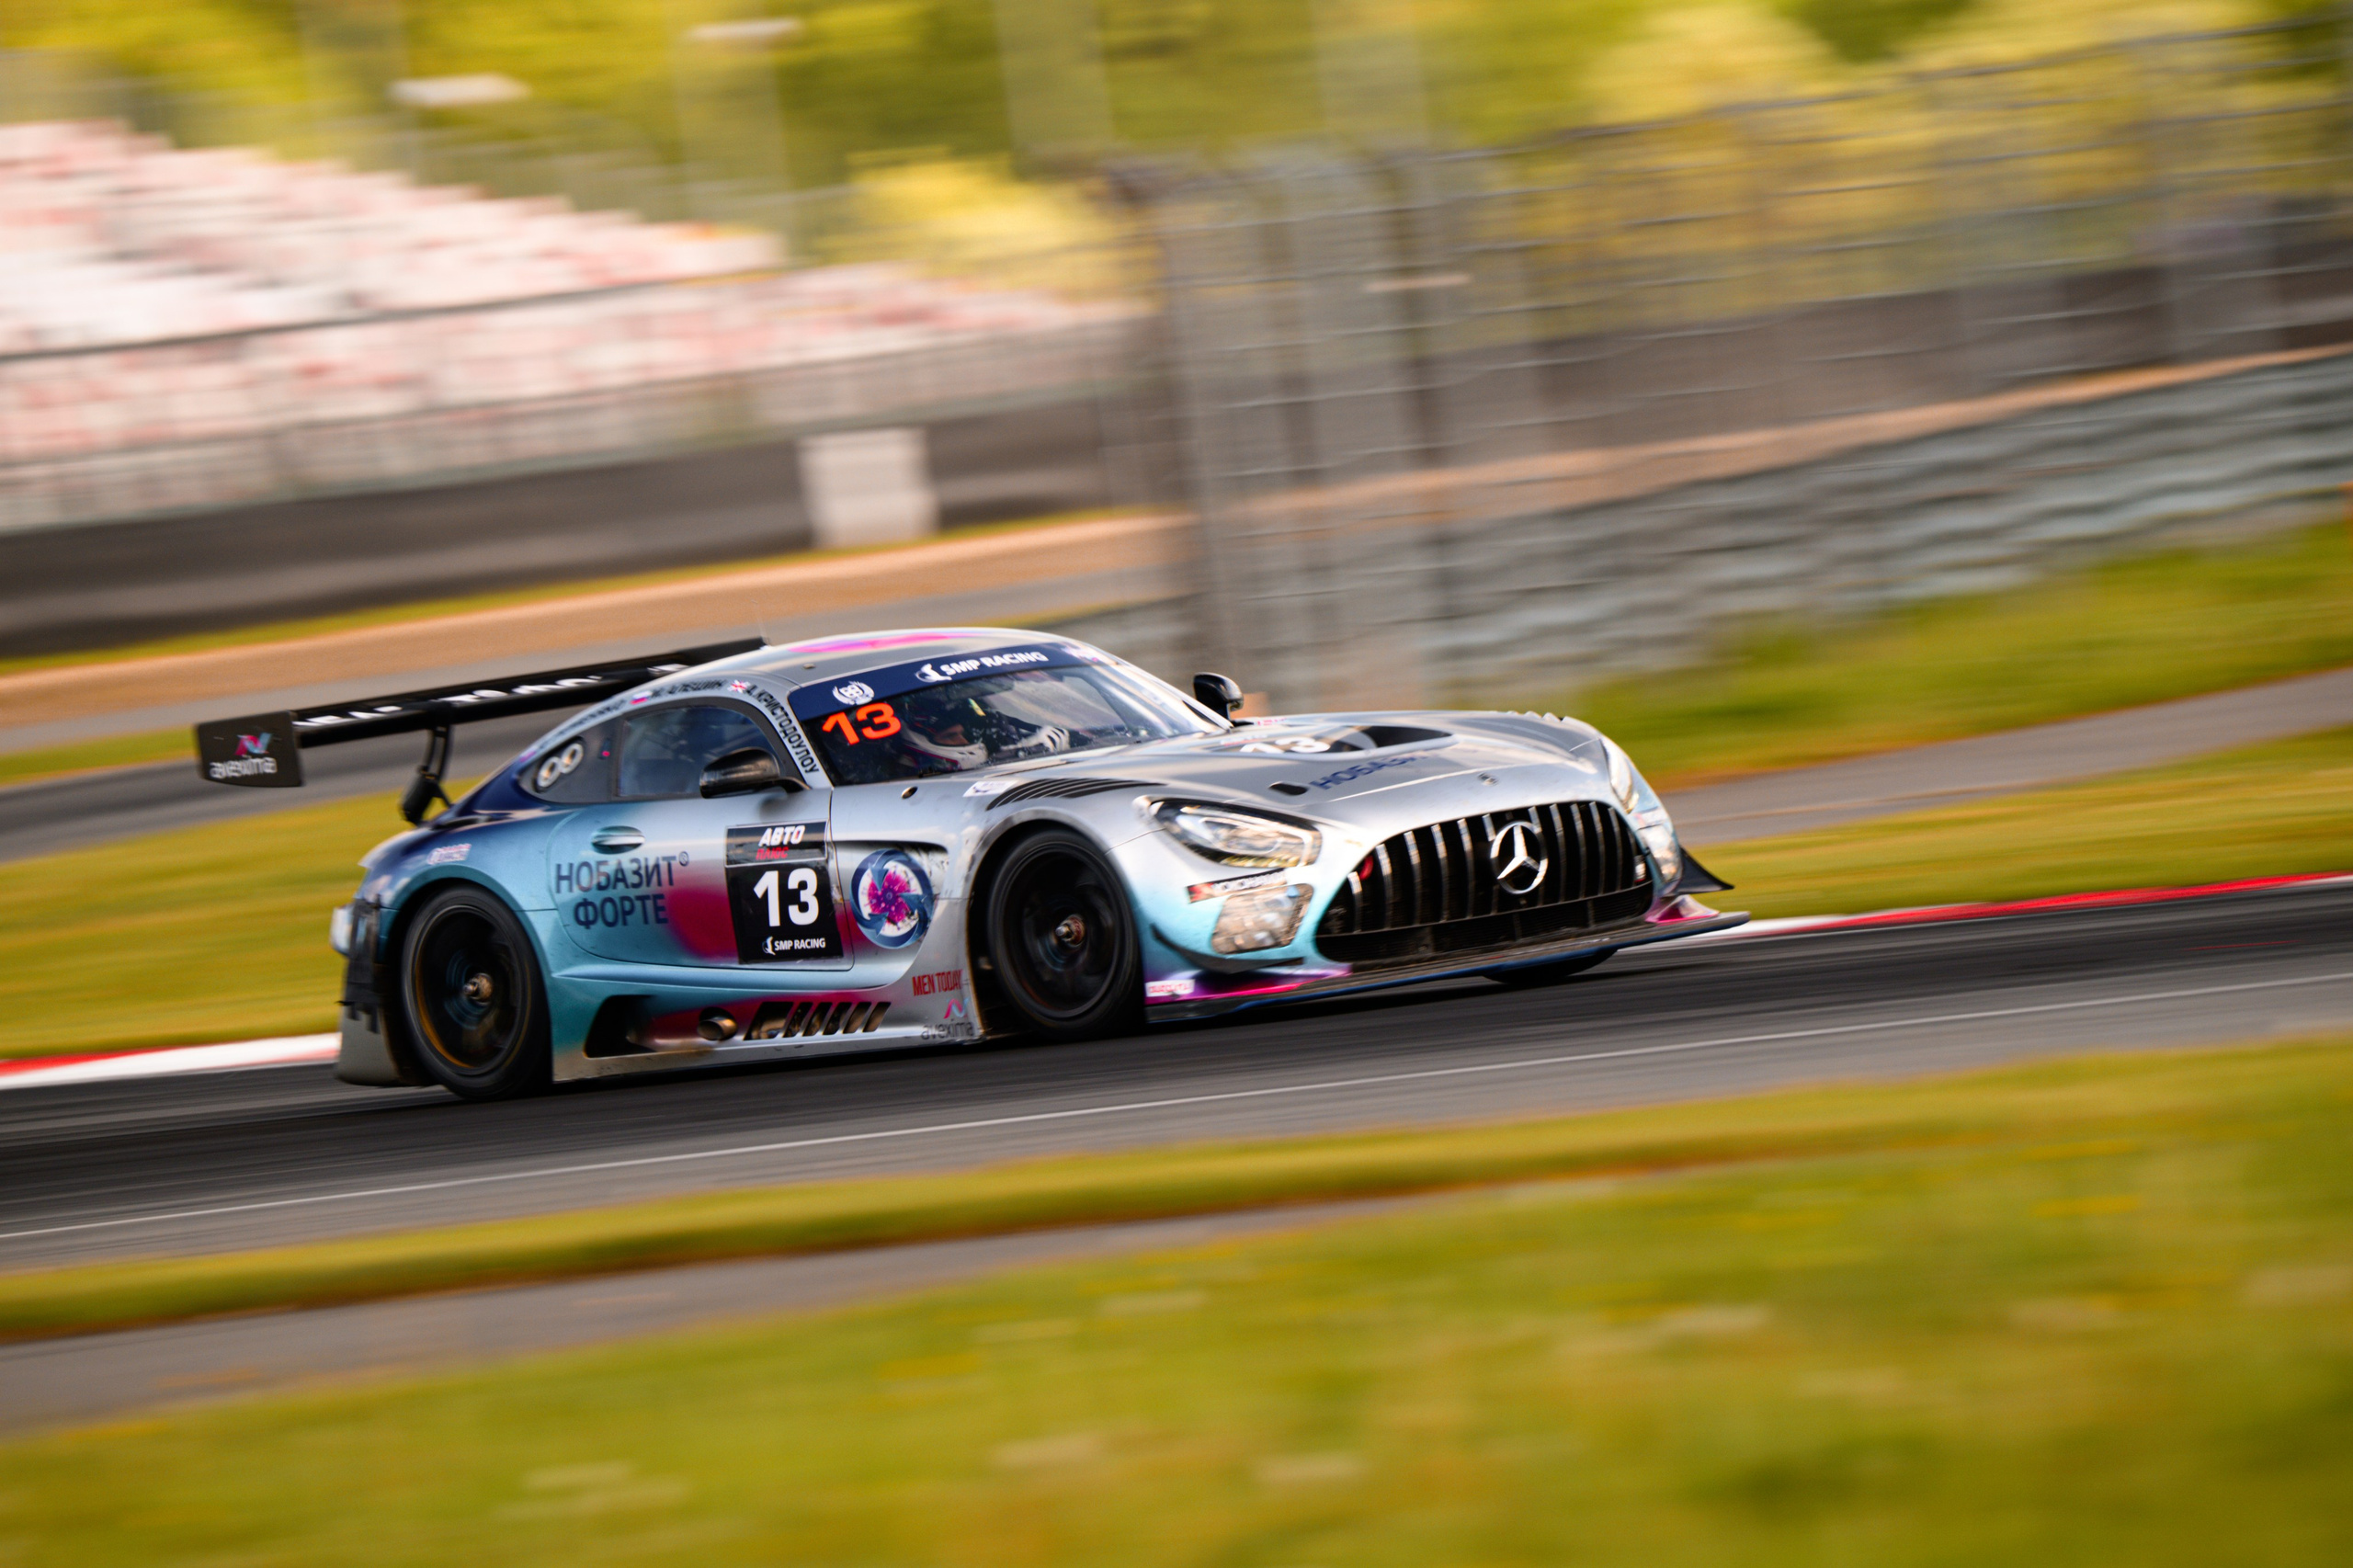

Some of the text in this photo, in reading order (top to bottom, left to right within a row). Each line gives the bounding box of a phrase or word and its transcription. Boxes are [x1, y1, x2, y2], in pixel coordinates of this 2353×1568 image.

[939, 651, 1049, 676] SMP RACING
[822, 702, 902, 745] 13
[758, 825, 805, 846] АВТО
[753, 868, 820, 927] 13
[574, 893, 669, 930] ФОРТЕ
[774, 937, 825, 950] SMP RACING
[912, 969, 963, 996] MEN TODAY
[921, 1017, 973, 1040] avexima
